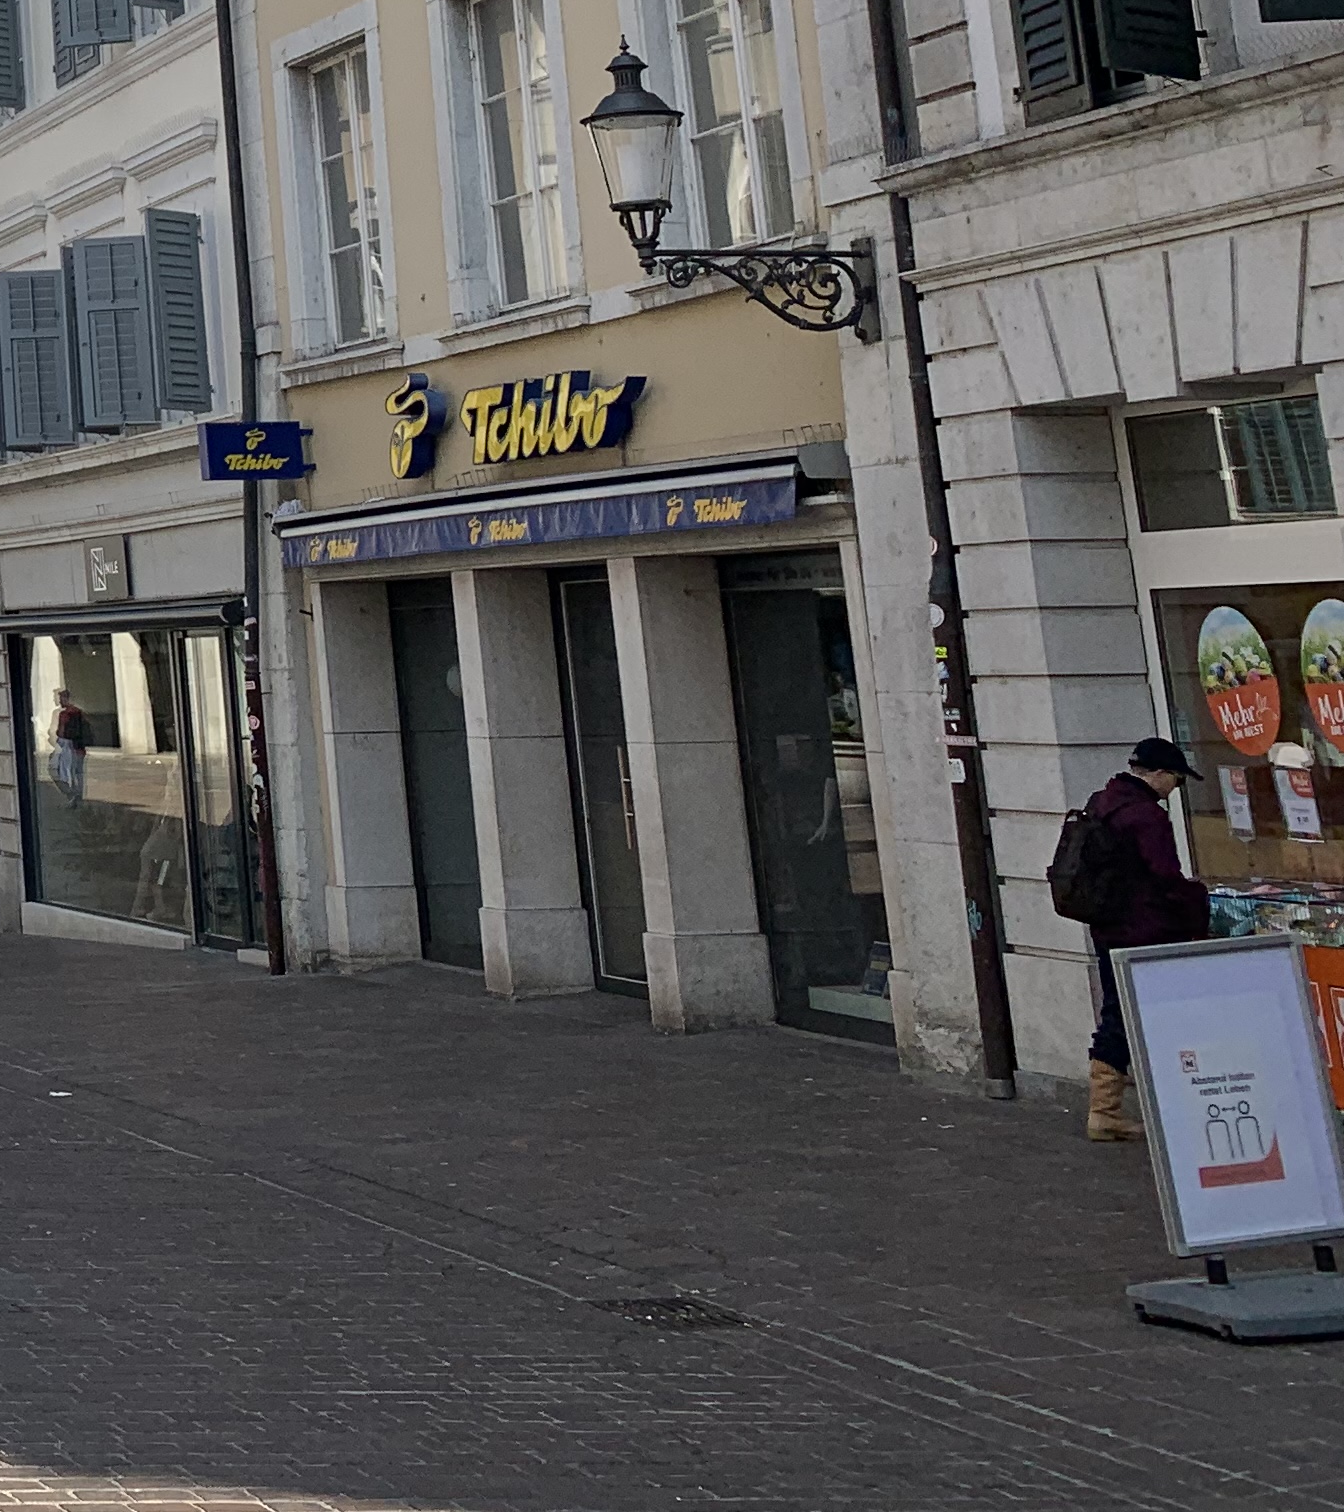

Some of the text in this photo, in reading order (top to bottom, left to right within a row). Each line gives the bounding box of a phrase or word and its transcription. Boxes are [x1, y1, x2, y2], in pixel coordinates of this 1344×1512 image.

[461, 371, 638, 465] Tchibo
[224, 453, 289, 470] Tchibo
[694, 496, 747, 522] Tchibo
[489, 518, 528, 542] Tchibo
[327, 538, 358, 560] Tchibo
[1218, 693, 1255, 732] Mehr
